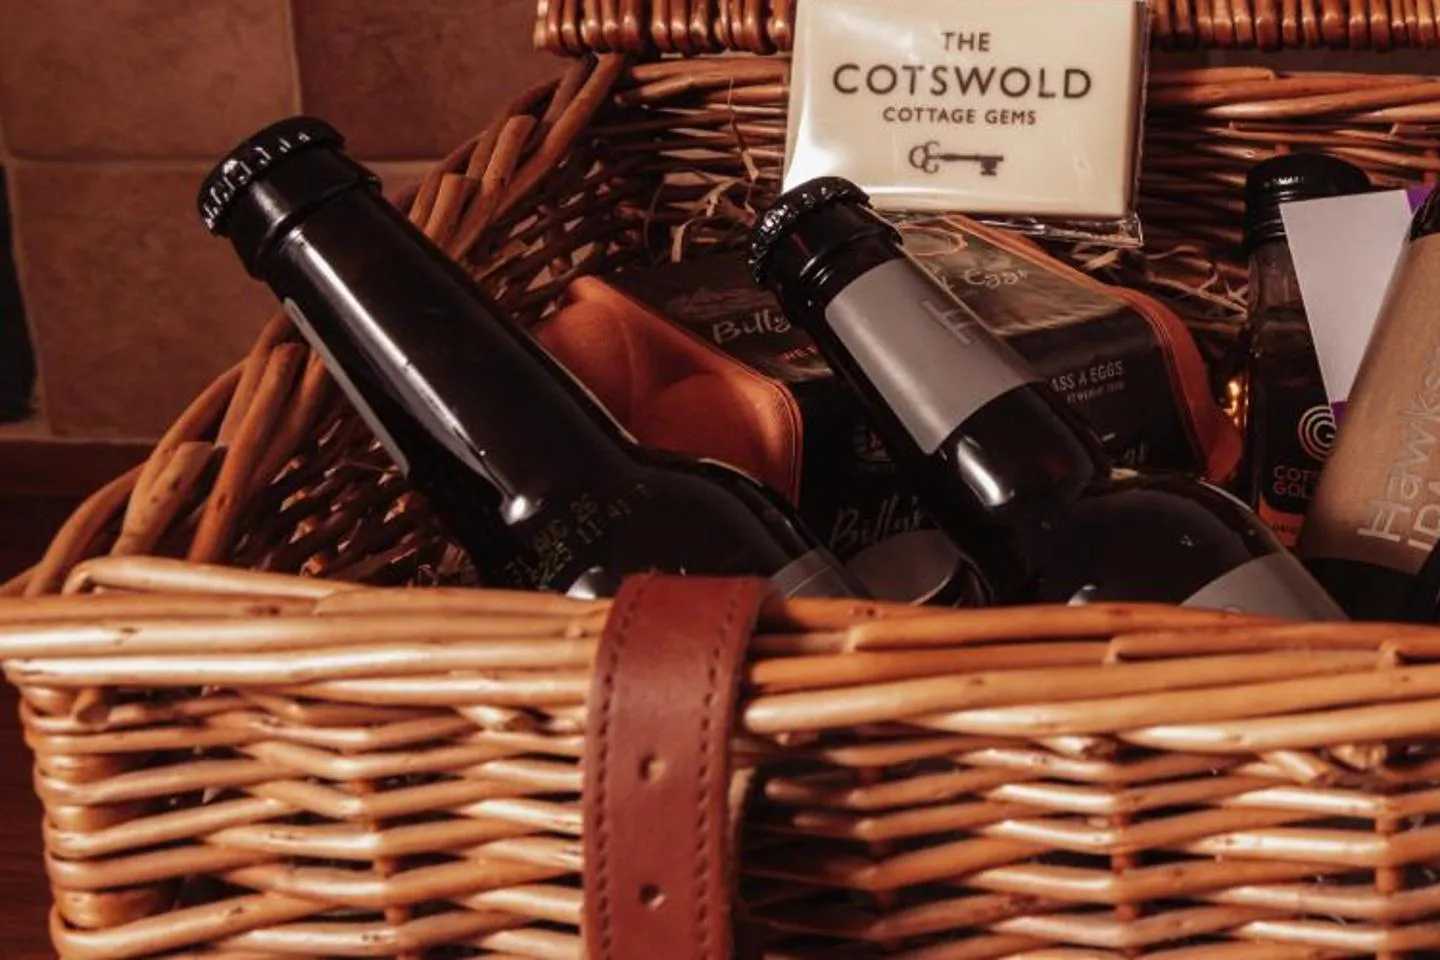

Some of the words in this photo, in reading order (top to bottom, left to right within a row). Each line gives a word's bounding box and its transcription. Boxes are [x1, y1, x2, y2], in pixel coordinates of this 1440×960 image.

[941, 32, 991, 51] THE
[832, 63, 1092, 99] COTSWOLD
[882, 106, 977, 124] COTTAGE
[985, 109, 1037, 125] GEMS
[1089, 361, 1124, 383] EGGS
[1272, 481, 1314, 500] GOL
